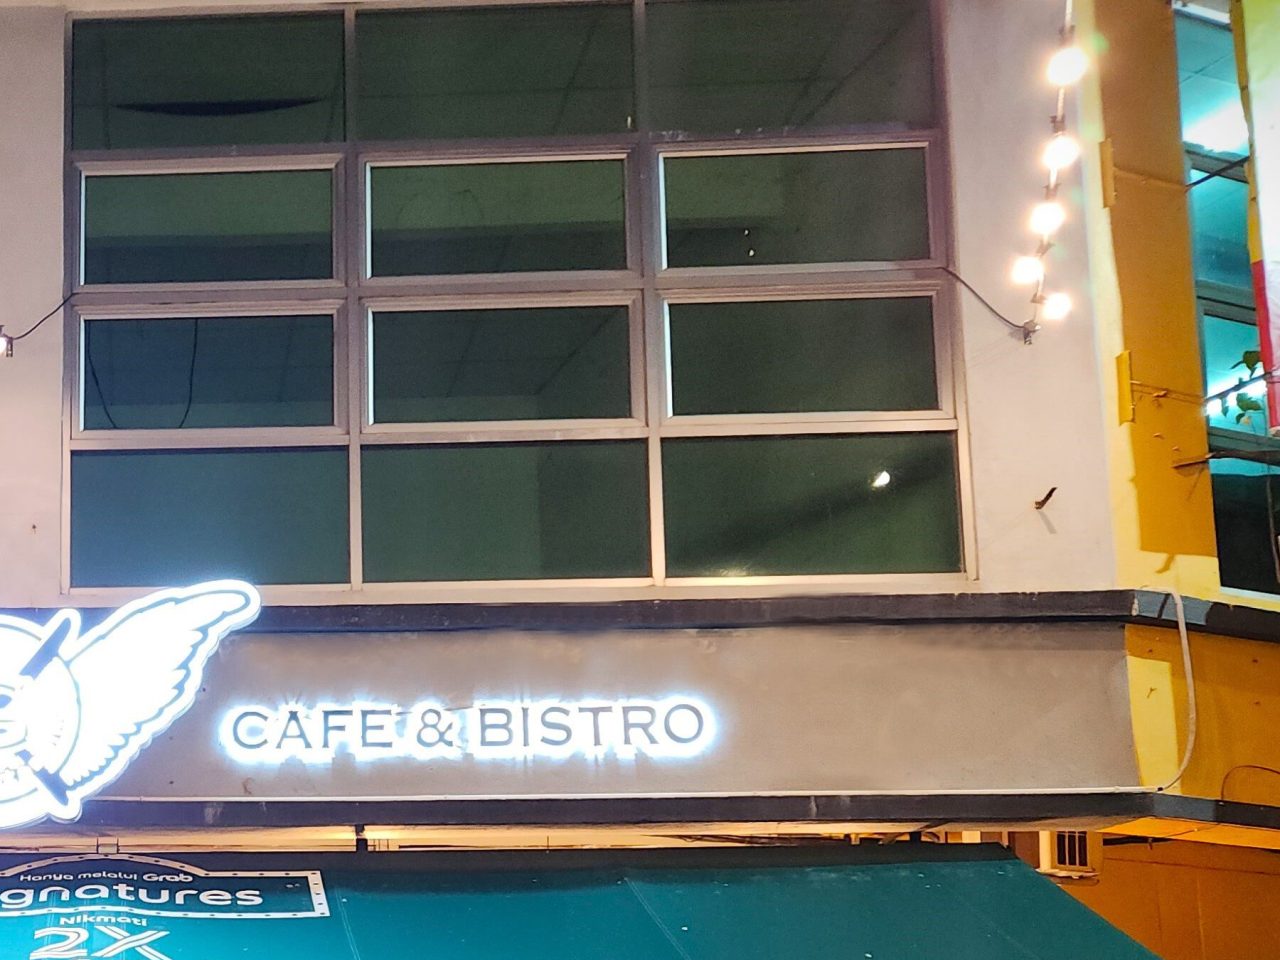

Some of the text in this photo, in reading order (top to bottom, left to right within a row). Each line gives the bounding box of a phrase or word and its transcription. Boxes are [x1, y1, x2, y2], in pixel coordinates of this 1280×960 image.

[231, 703, 705, 749] CAFE & BISTRO
[20, 871, 193, 883] Hanya melalui Grab
[59, 915, 147, 927] Nikmati
[30, 926, 173, 960] 2X
